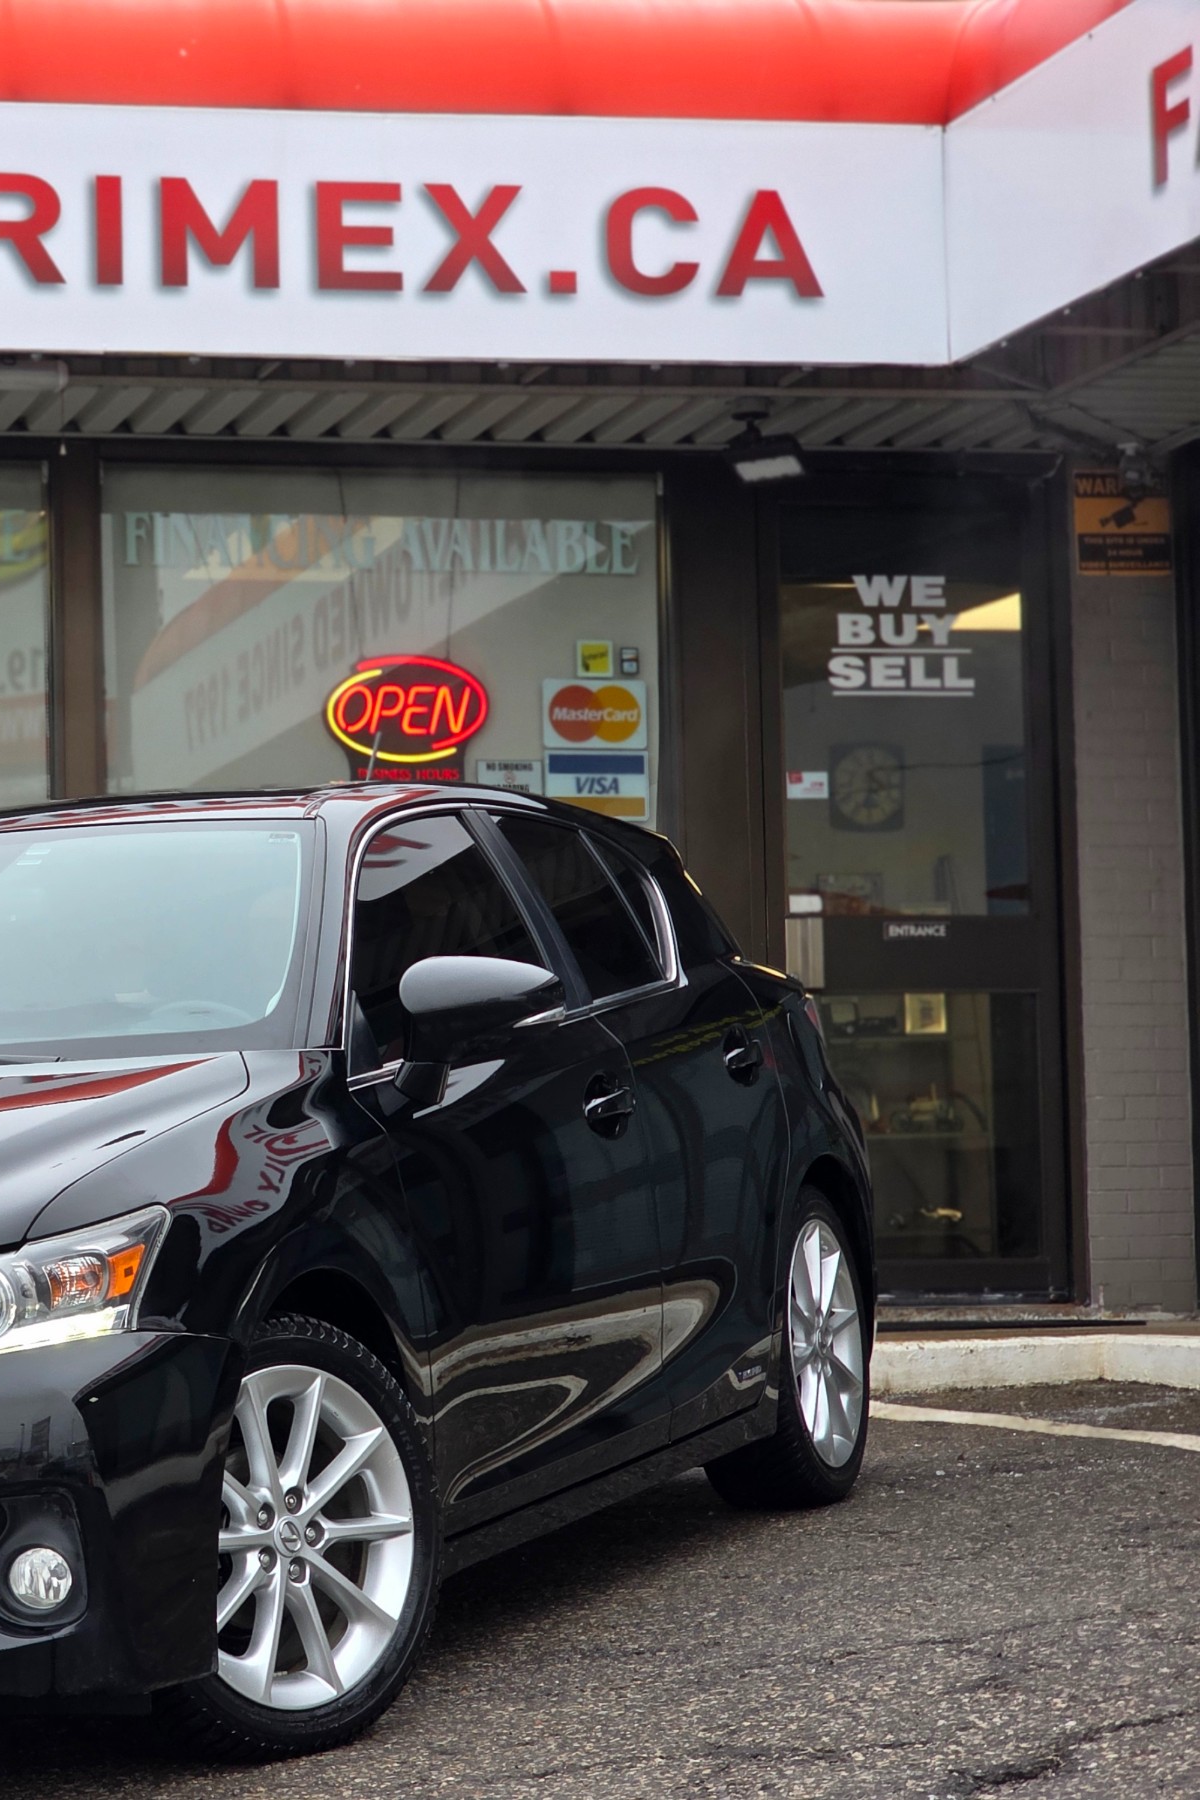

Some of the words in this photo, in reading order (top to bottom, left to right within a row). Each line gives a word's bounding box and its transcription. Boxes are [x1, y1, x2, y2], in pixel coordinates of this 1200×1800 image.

[399, 518, 640, 575] AVAILABLE
[852, 575, 946, 607] WE
[837, 613, 956, 645] BUY
[828, 655, 975, 688] SELL
[336, 684, 471, 735] OPEN
[552, 706, 639, 722] MasterCard
[574, 776, 620, 795] VISA
[888, 924, 947, 937] ENTRANCE
